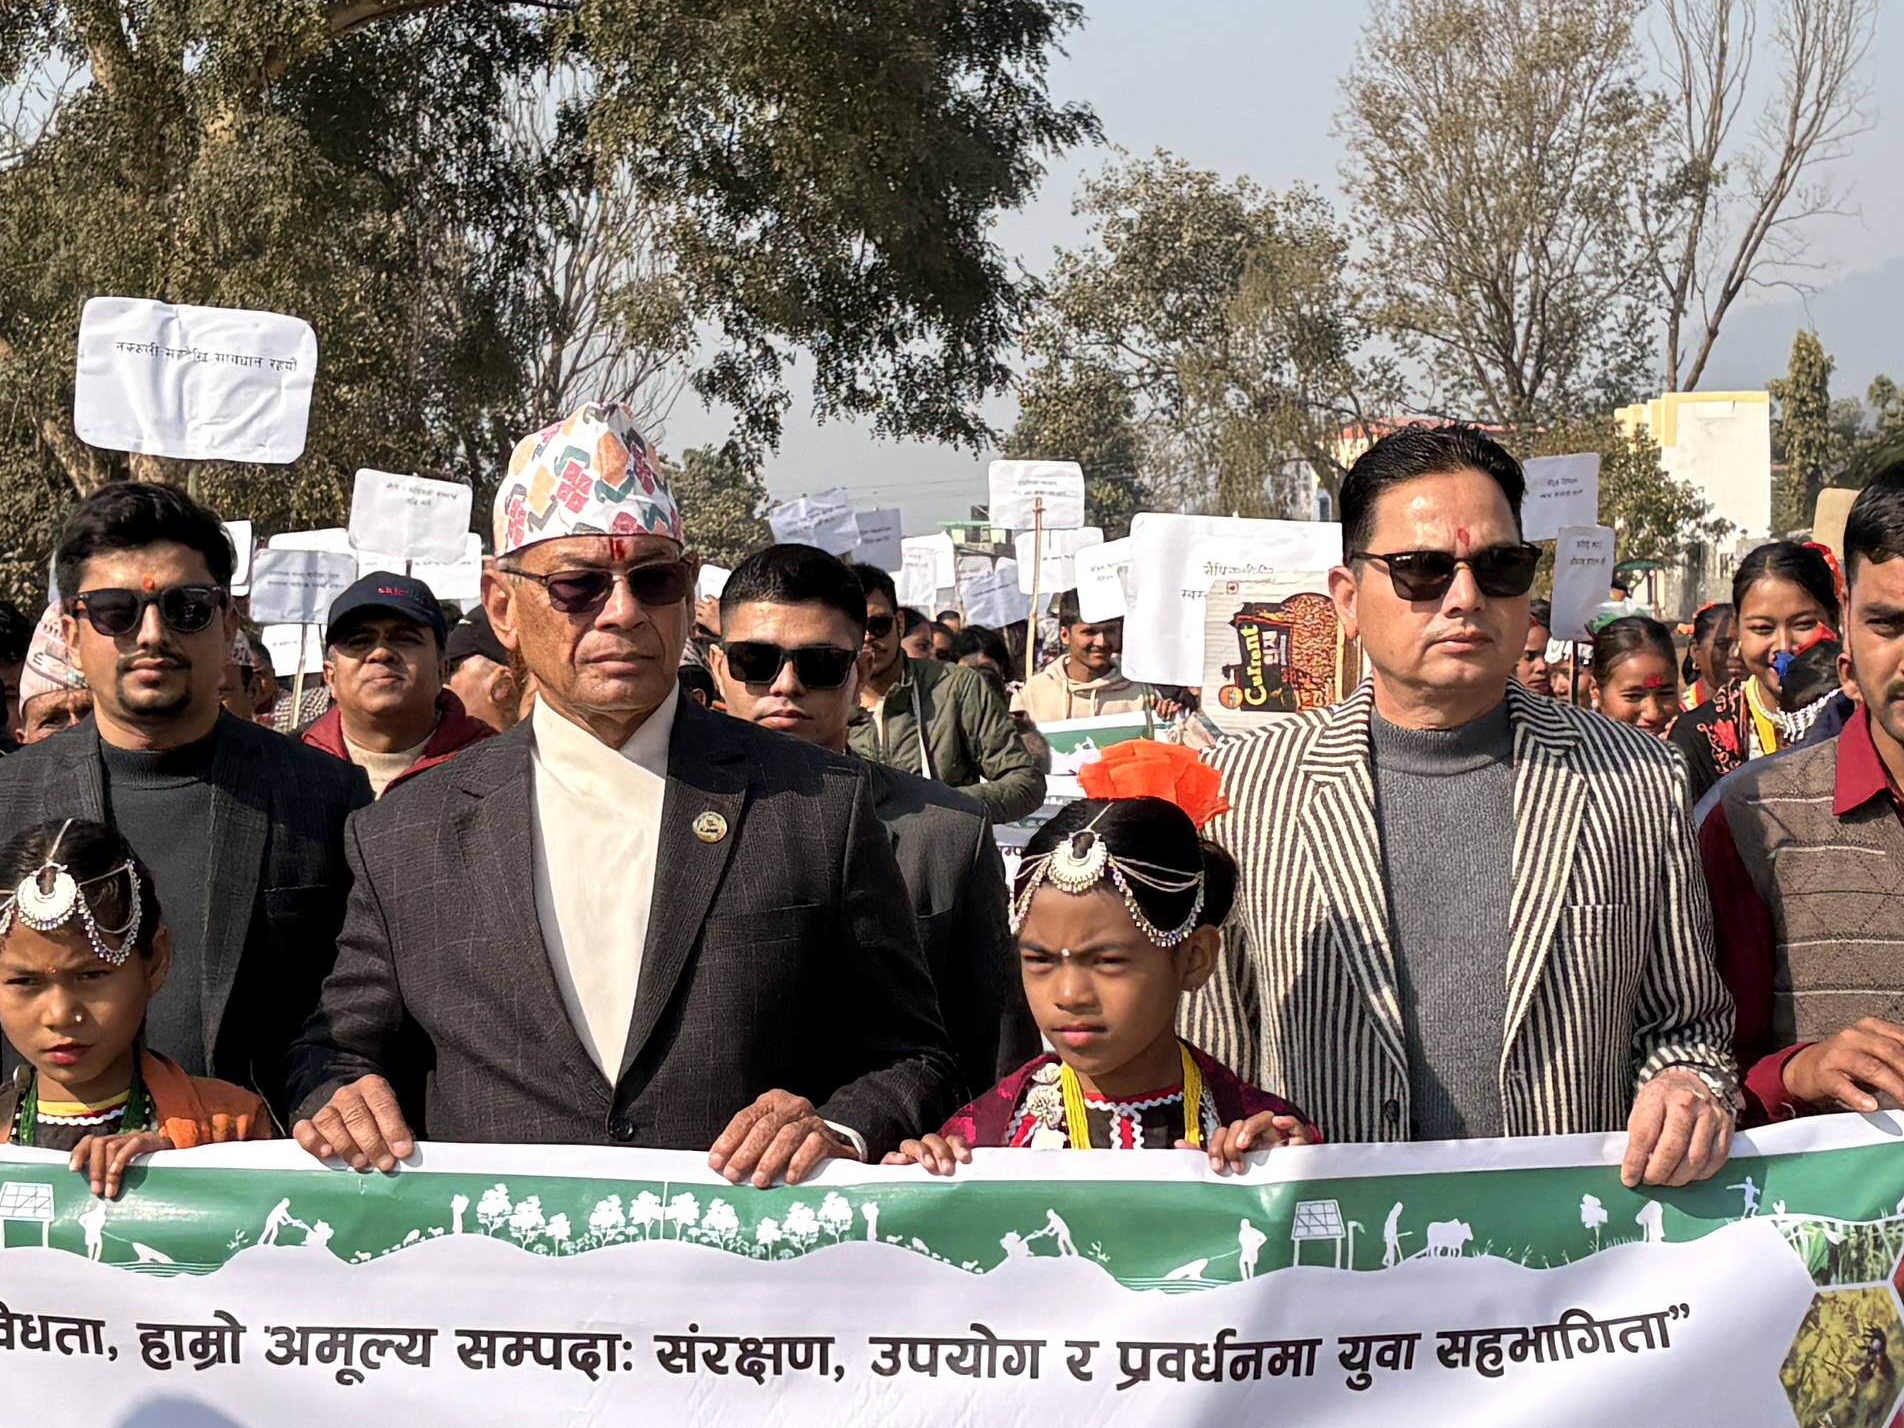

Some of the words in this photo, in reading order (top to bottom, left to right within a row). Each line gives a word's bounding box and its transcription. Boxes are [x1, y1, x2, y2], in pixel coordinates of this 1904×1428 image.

[135, 1309, 248, 1372] हाम्रो
[263, 1325, 439, 1386] अमूल्य
[653, 1322, 845, 1386] संरक्षण,
[868, 1322, 1047, 1380] उपयोग
[1064, 1339, 1099, 1382] र
[1116, 1327, 1324, 1391] प्रवर्धनमा
[1337, 1332, 1423, 1392] युवा
[1435, 1302, 1690, 1378] सहभागिता”
